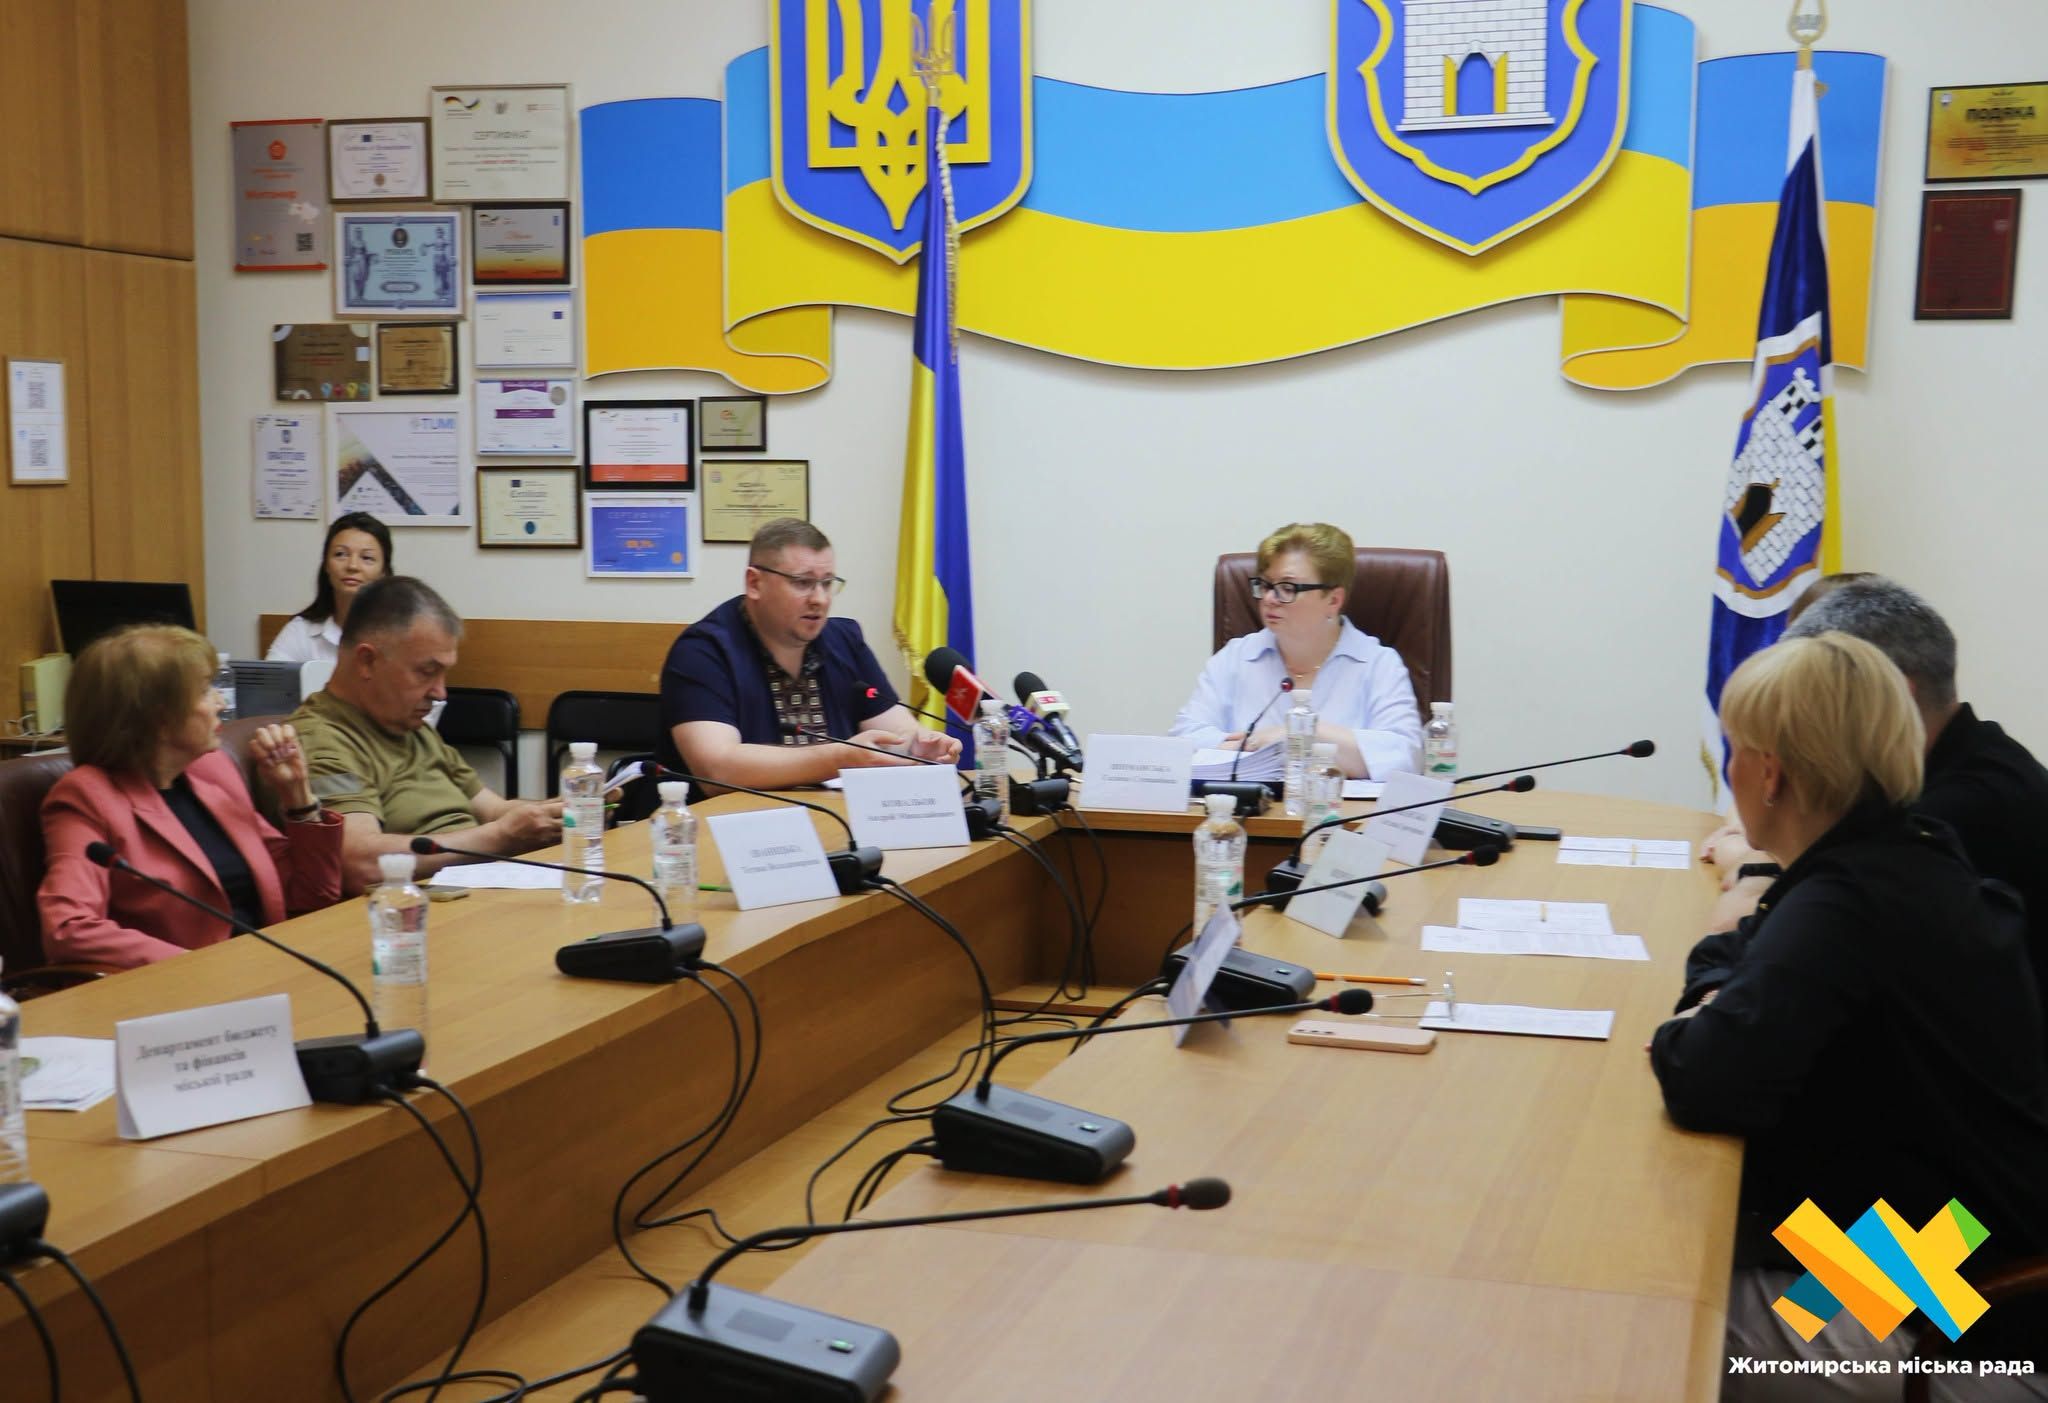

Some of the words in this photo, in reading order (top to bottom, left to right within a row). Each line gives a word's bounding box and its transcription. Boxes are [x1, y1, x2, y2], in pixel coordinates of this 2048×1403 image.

[137, 1034, 220, 1060] Департамент
[224, 1024, 278, 1043] бюджету
[174, 1061, 189, 1072] та
[193, 1049, 247, 1071] фінансів
[225, 1069, 255, 1086] ради
